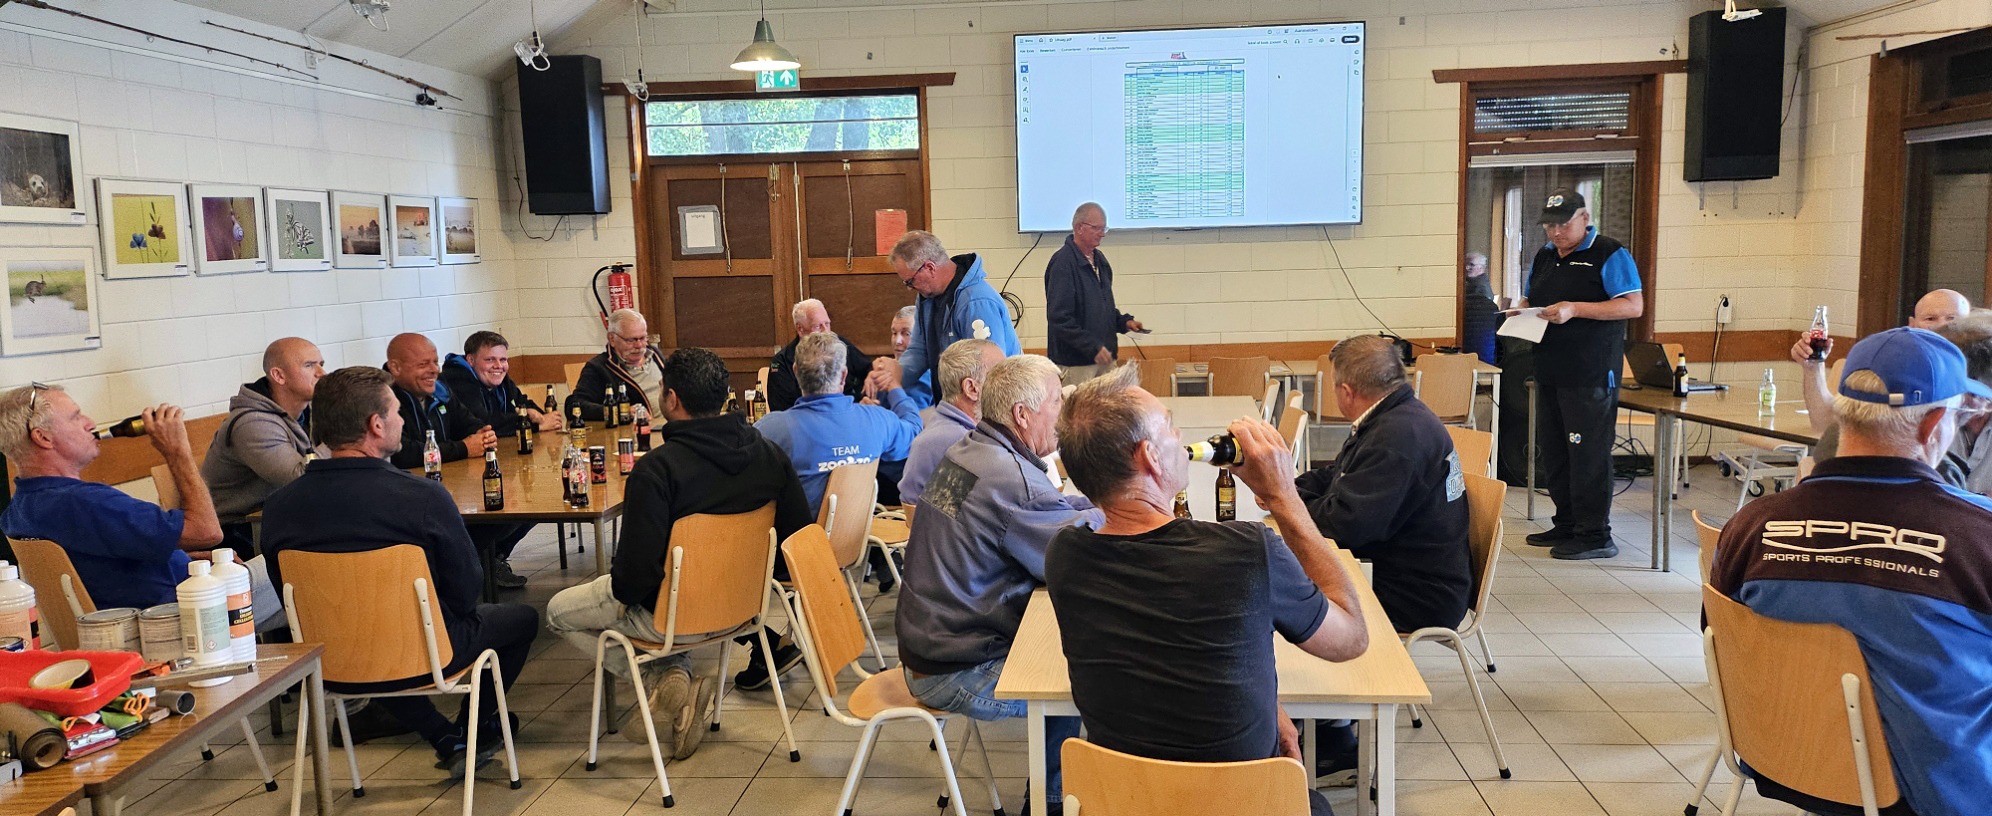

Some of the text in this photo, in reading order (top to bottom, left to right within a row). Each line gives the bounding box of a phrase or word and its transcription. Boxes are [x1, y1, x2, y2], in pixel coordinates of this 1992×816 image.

[832, 445, 860, 456] TEAM
[1763, 520, 1946, 555] SPRO
[1762, 553, 1940, 578] SPORTS PROFESSIONALS
